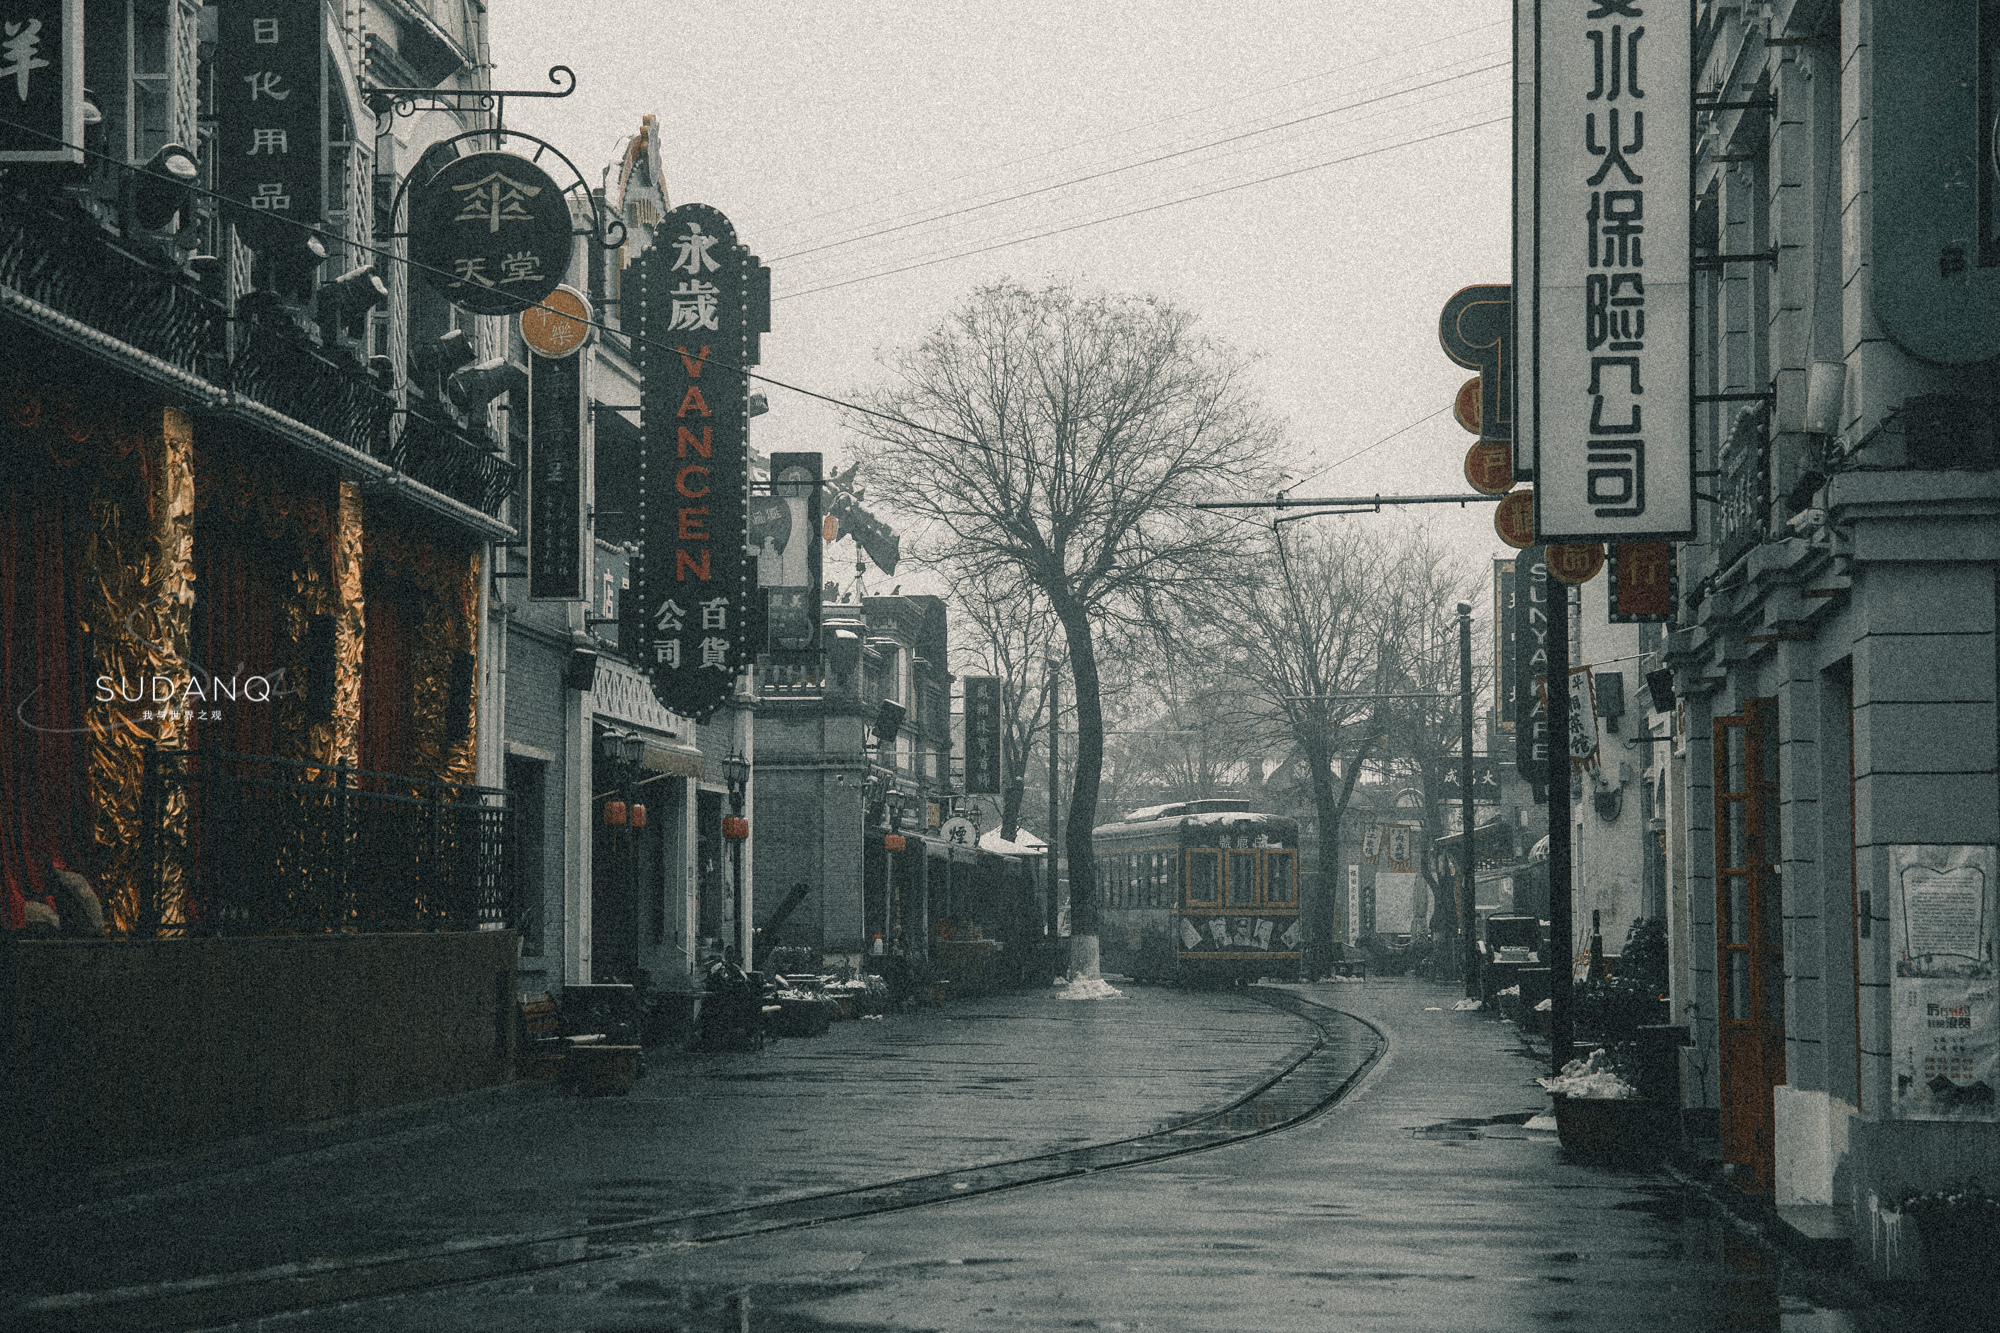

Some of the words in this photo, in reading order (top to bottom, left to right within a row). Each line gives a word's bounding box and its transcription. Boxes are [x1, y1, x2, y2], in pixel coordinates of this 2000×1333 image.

[0, 18, 51, 102] 羊
[243, 17, 291, 210] 日化用品
[448, 250, 546, 288] 天堂
[667, 221, 722, 334] 永歲
[674, 344, 713, 583] VANCEN
[653, 597, 687, 670] 公司
[697, 597, 732, 672] 百貨
